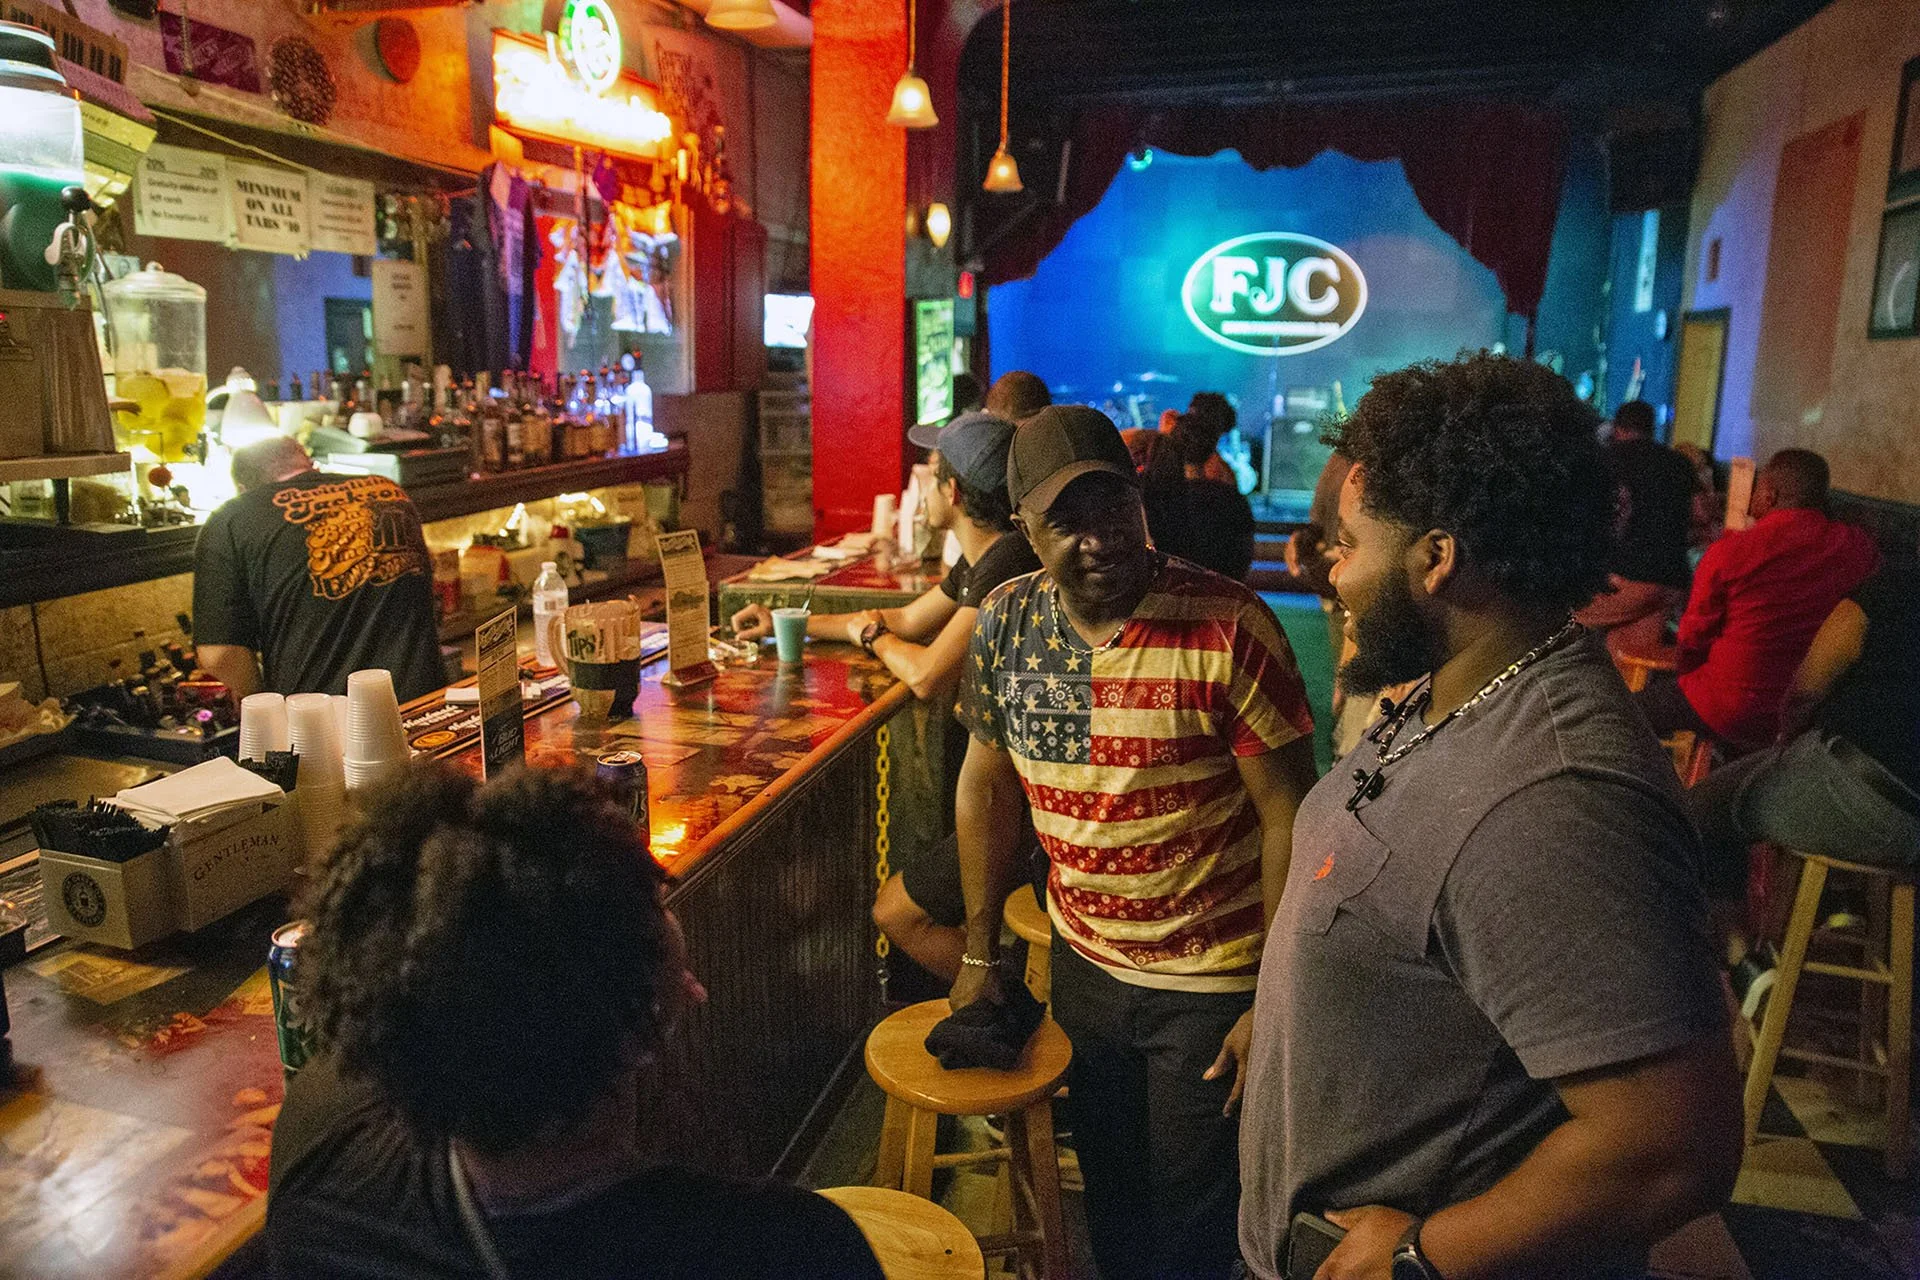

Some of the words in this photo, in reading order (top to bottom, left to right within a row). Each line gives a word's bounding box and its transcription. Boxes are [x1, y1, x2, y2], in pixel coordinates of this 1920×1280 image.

[236, 178, 301, 202] MINIMUM
[245, 197, 266, 212] ON
[271, 201, 294, 217] ALL
[245, 213, 280, 229] TABS
[1208, 255, 1341, 316] FJC
[193, 834, 280, 881] GENTLEMAN
